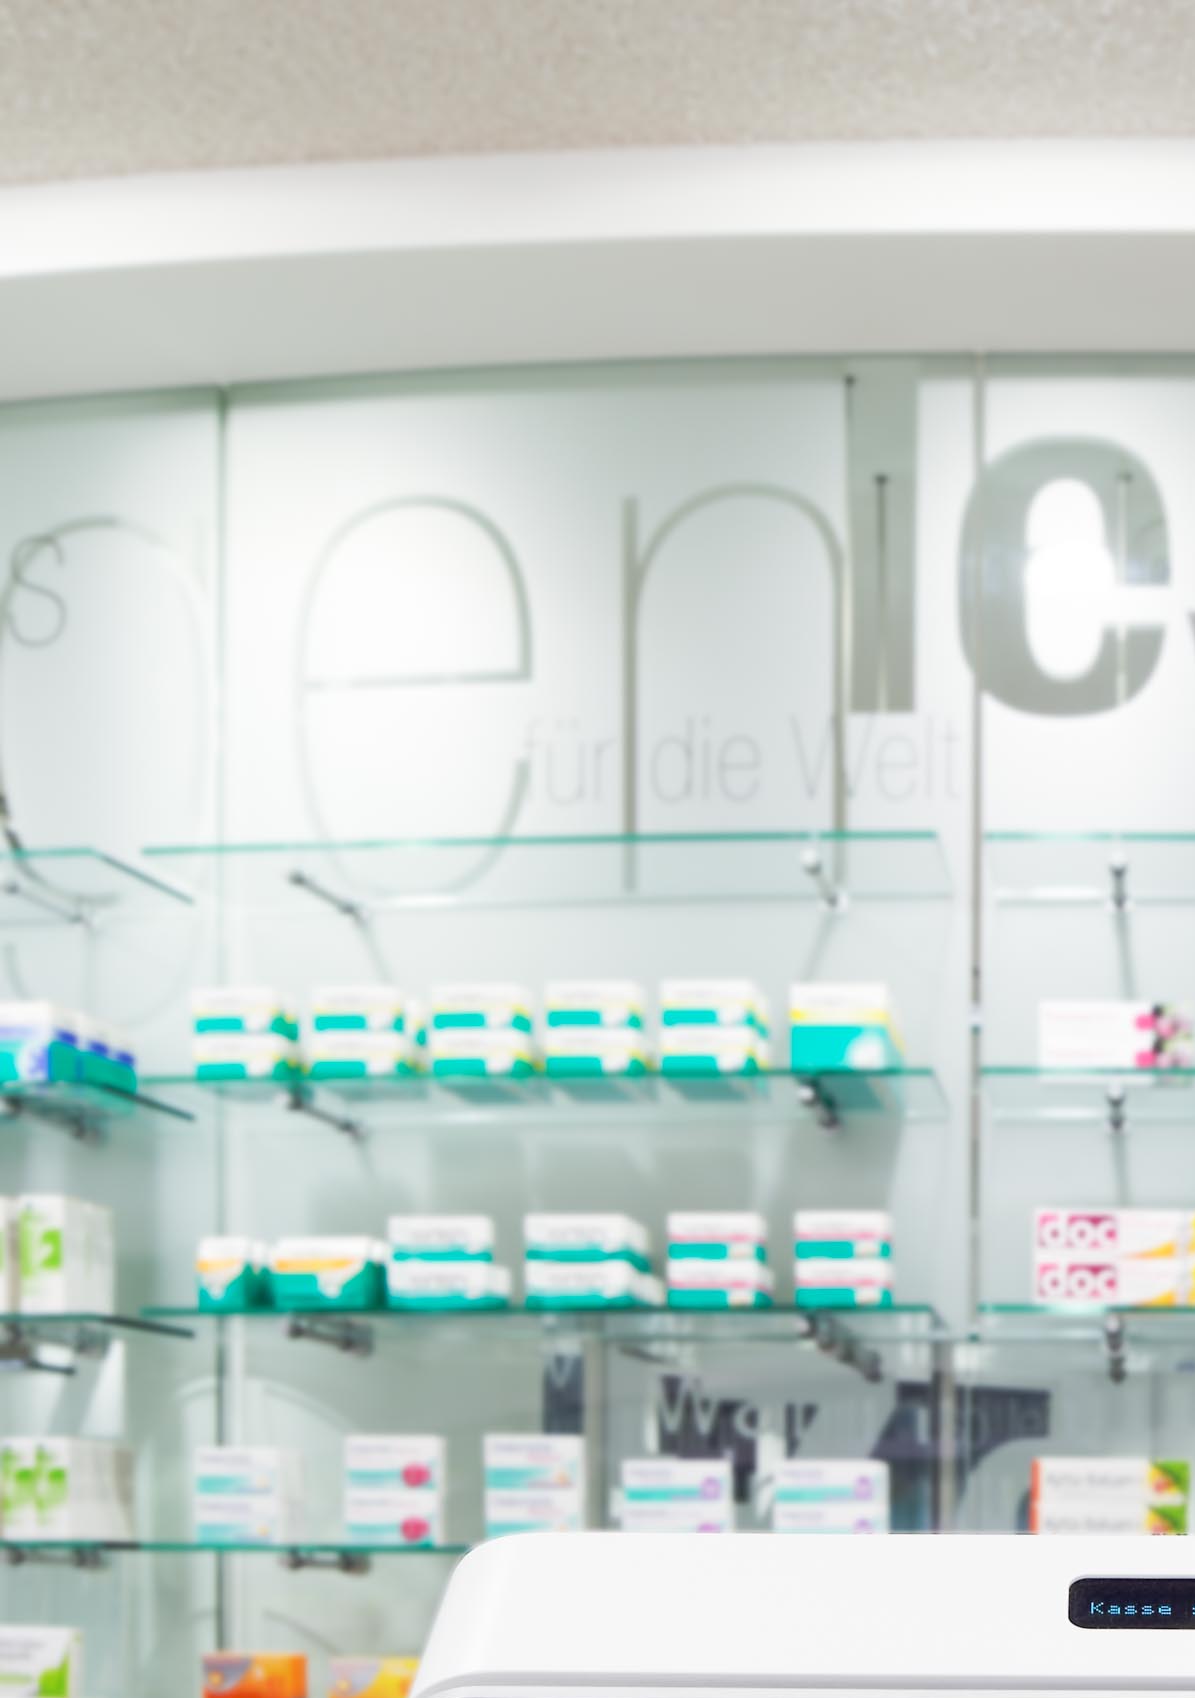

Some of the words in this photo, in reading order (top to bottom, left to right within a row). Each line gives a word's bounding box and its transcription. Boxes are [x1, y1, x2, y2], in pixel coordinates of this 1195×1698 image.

[522, 715, 618, 806] für
[649, 713, 763, 804] die
[788, 712, 963, 804] Welt
[1090, 1602, 1172, 1615] Kasse
